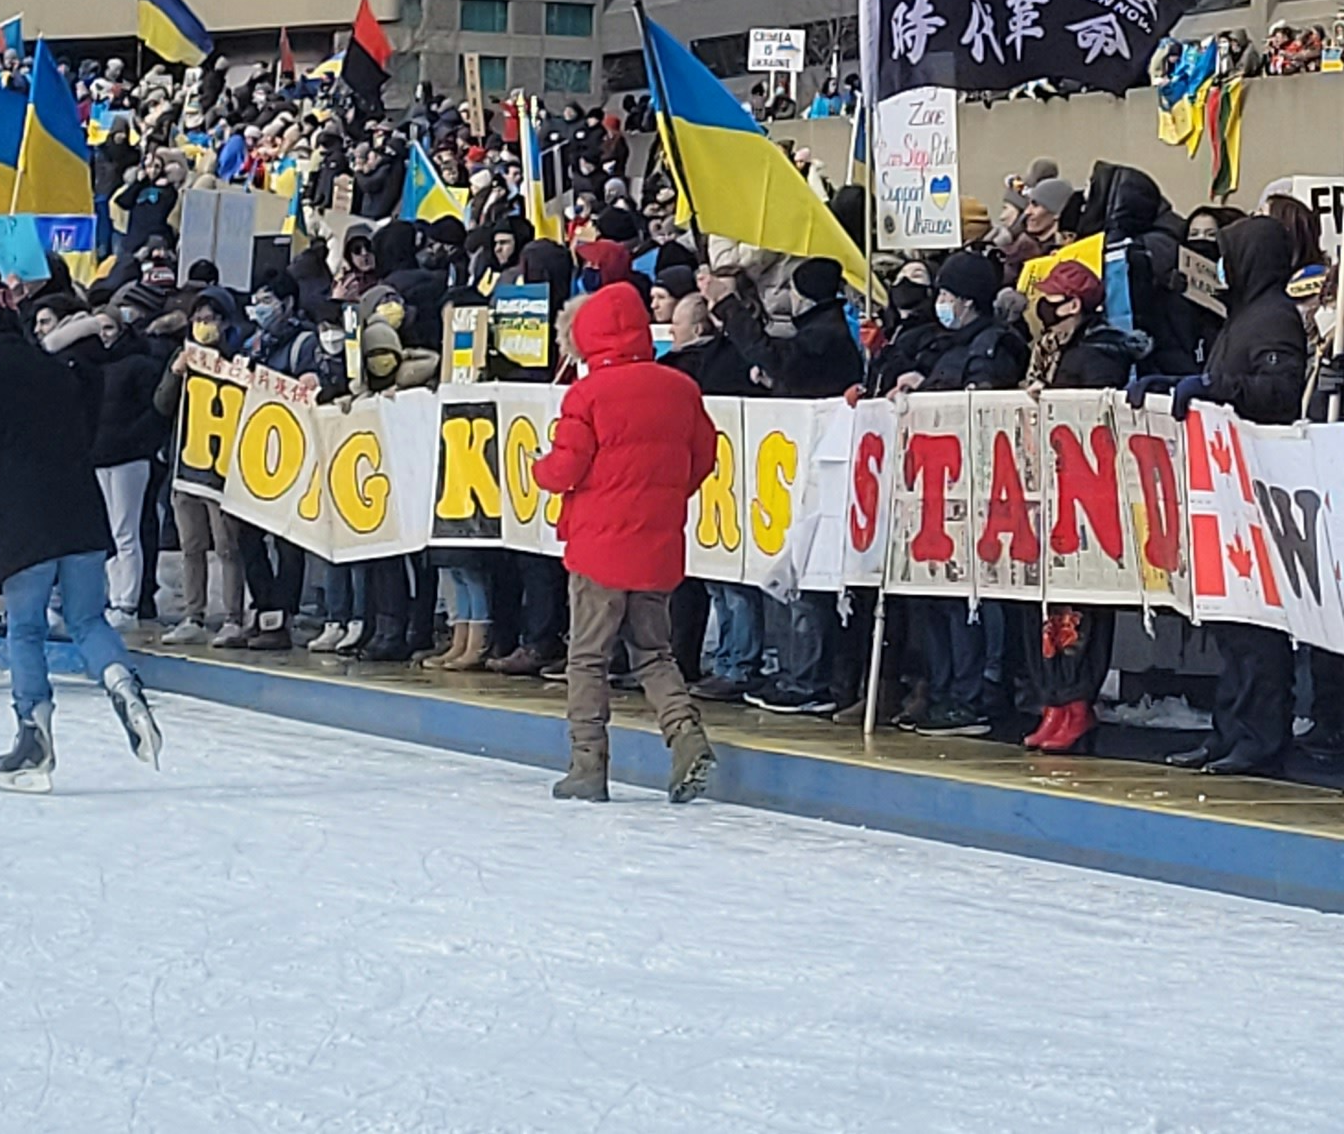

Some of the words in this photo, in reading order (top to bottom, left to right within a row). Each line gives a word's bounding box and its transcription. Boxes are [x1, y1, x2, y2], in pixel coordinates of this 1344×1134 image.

[182, 375, 391, 534] HOG
[435, 416, 799, 556] KORS
[850, 423, 1182, 573] STAND
